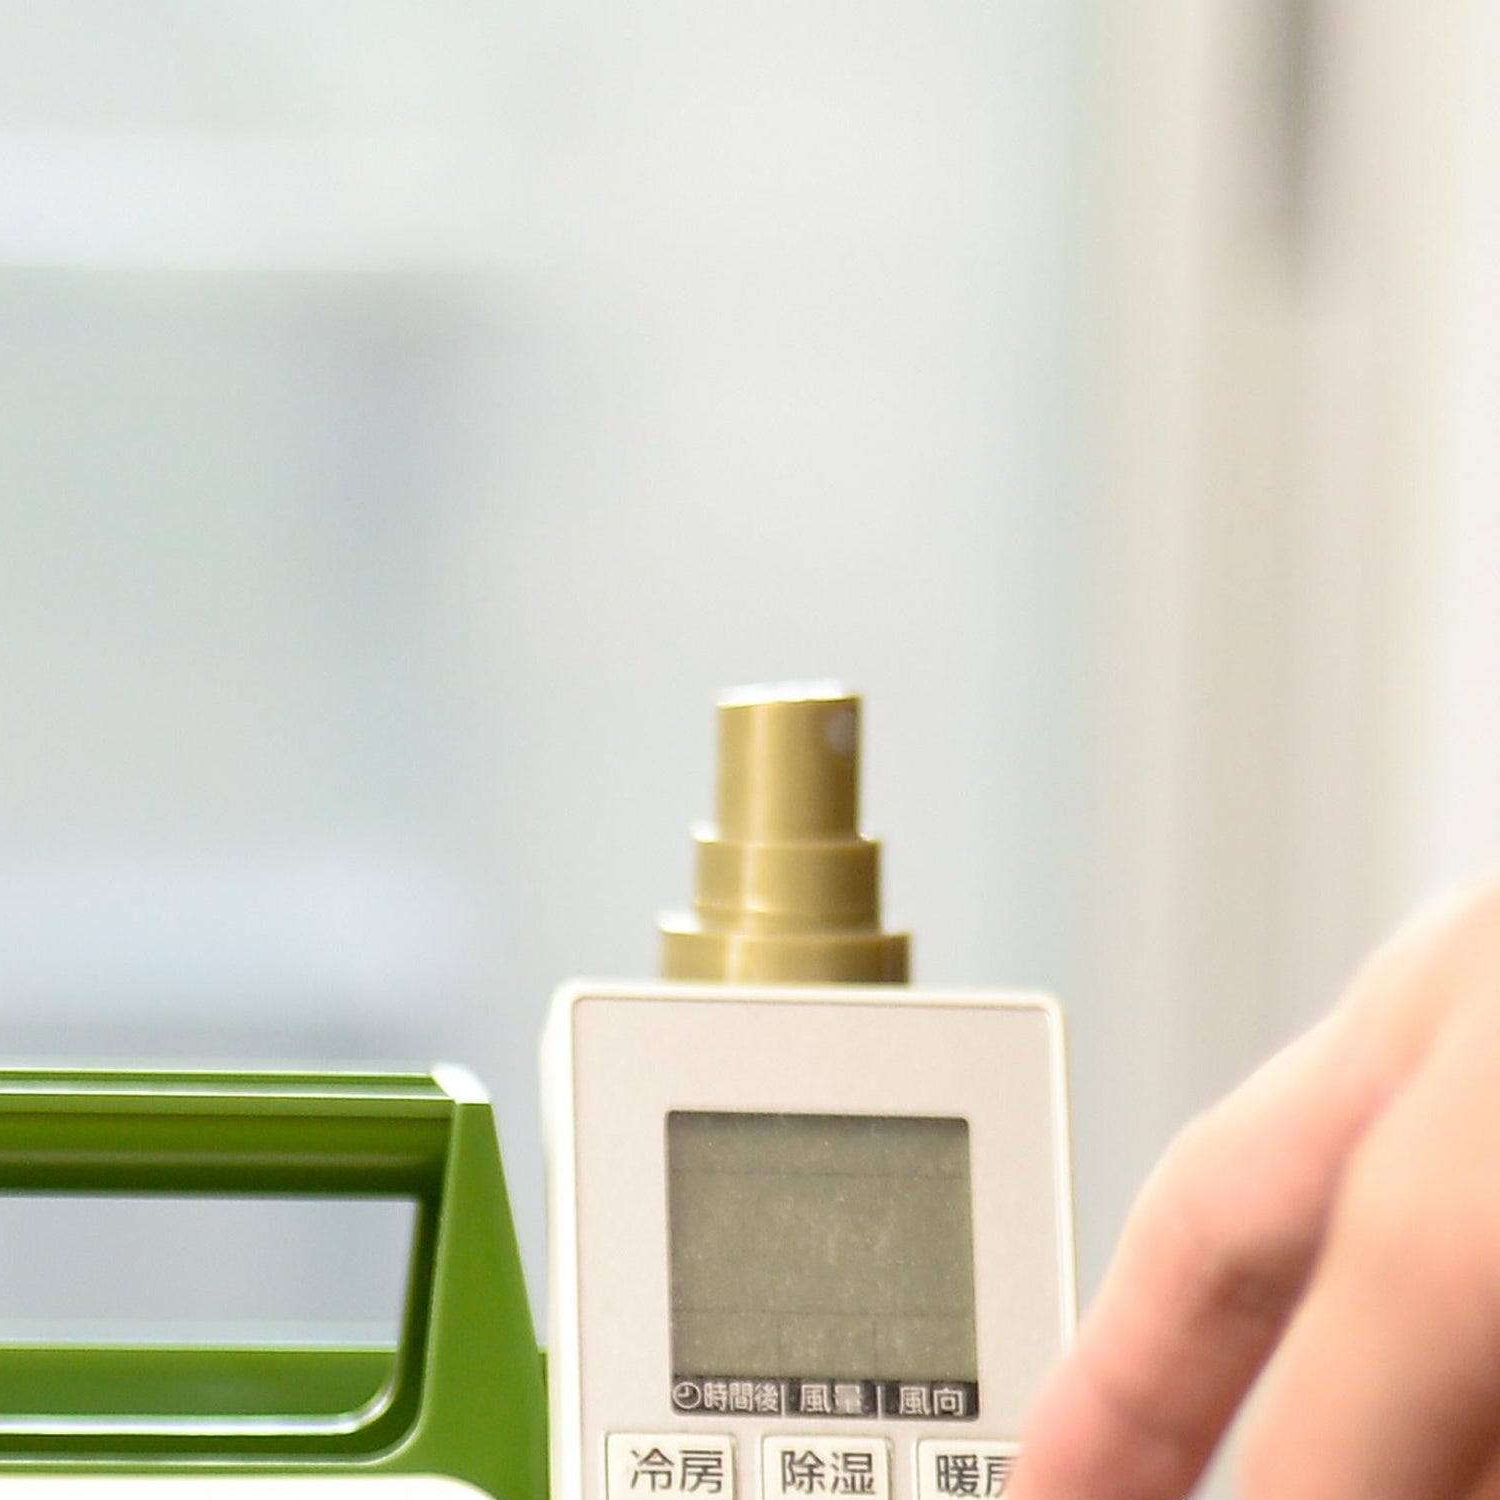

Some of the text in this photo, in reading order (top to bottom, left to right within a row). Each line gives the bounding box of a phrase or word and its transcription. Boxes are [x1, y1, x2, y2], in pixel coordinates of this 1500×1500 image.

[703, 1382, 780, 1412] 時間後
[899, 1386, 965, 1416] 風向
[630, 1447, 725, 1494] 冷房
[781, 1450, 876, 1495] 除湿
